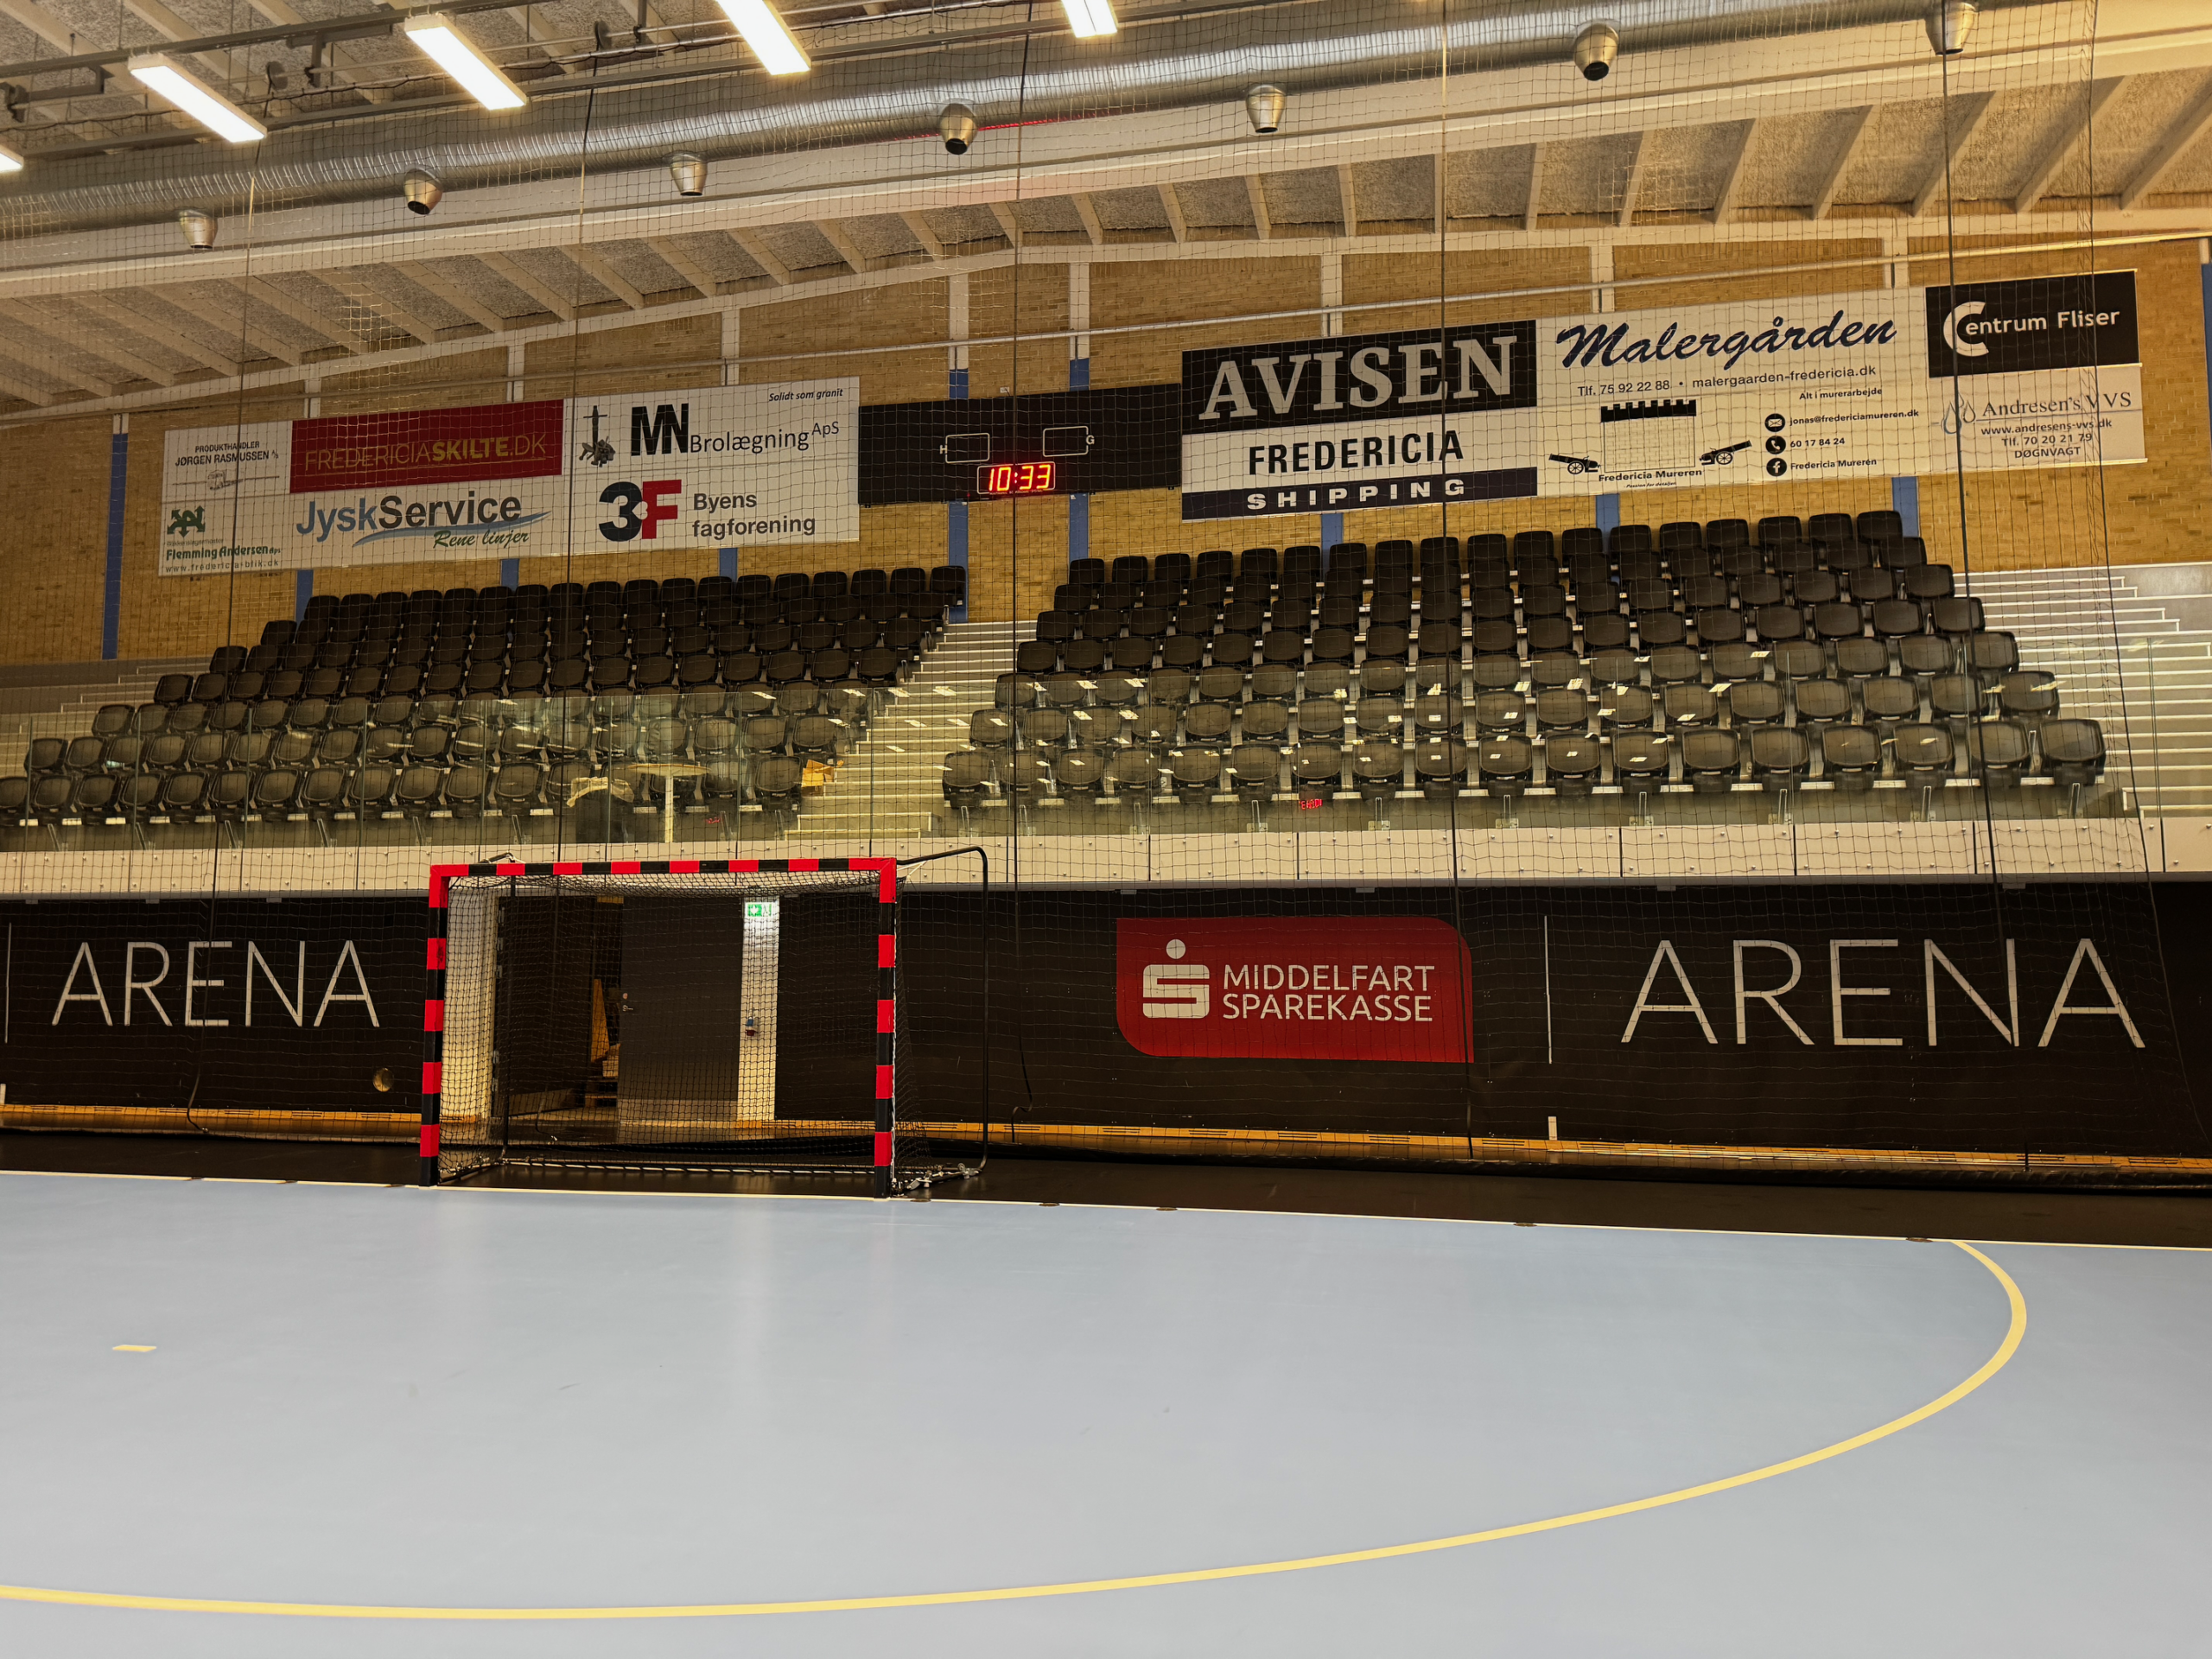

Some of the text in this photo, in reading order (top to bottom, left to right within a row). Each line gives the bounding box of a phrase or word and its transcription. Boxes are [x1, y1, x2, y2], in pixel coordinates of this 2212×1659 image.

[1555, 309, 1897, 371] Malergården
[1943, 301, 2120, 357] Centrum Fliser
[1198, 335, 1517, 421] AVISEN
[1578, 365, 1877, 397] Tlf. 75 92 22 88 malergaarden-fredericia.dk
[768, 388, 844, 403] Solidt som granit
[1799, 391, 1813, 400] Alt
[1820, 387, 1883, 399] murerarbejde
[1982, 391, 2133, 417] Andresen's VVS
[631, 403, 689, 457] MN
[1789, 409, 1919, 427] jonas@fredericiamureren.dk
[195, 441, 260, 454] PRODUKTHANDLER
[690, 421, 840, 454] Brolægning ApS
[939, 445, 948, 454] H
[1085, 435, 1095, 445] G
[1789, 440, 1802, 448] 60
[1819, 438, 1831, 447] 84
[1833, 437, 1846, 446] 24
[2001, 433, 2093, 448] Tlf. 70 20 21 79
[175, 454, 213, 467] JØRGEN
[214, 450, 270, 464] RASMUSSEN
[304, 433, 547, 472] FREDERICIASKILTE.DK
[1249, 430, 1464, 475] FREDERICIA
[1790, 459, 1877, 471] Fredericia Mureren
[2014, 446, 2082, 459] DØGNVAGT
[988, 464, 1052, 492] 10:33
[1599, 469, 1702, 482] Fredericia Mureren
[693, 491, 758, 514] Byens
[1247, 479, 1465, 511] SHIPPING
[296, 490, 522, 543] JyskService
[598, 479, 683, 542] 3F
[433, 528, 530, 550] Rene linjer
[691, 515, 817, 540] fagforening
[166, 547, 218, 562] Flemming
[219, 545, 269, 558] Andersen
[166, 559, 279, 573] www.frederica-blik.dk
[51, 939, 380, 1027] ARENA
[1223, 963, 1435, 992] MIDDELFART
[1620, 938, 2146, 1049] ARENA
[1223, 993, 1433, 1022] SPAREKASSE
